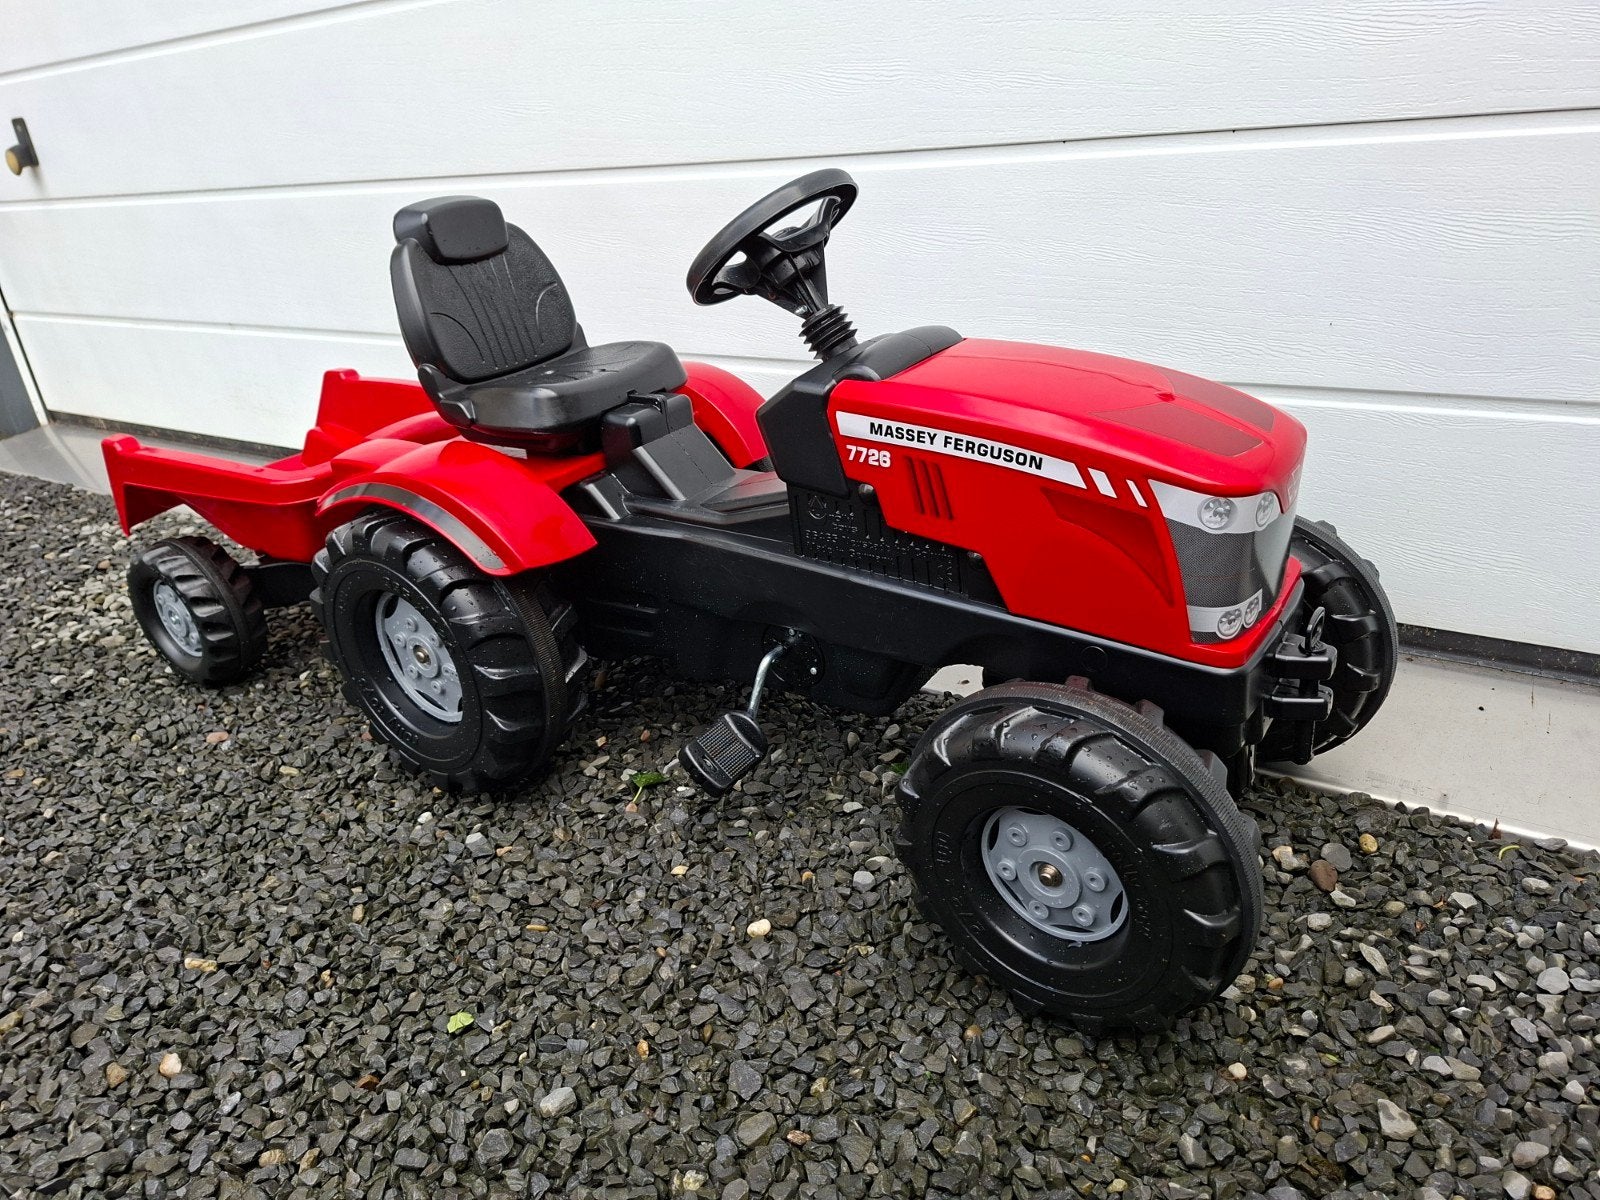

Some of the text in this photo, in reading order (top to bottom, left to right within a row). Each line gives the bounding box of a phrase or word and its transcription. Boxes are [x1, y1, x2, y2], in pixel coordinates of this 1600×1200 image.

[846, 444, 891, 468] 7726
[869, 422, 1044, 471] MASSEY FERGUSON
